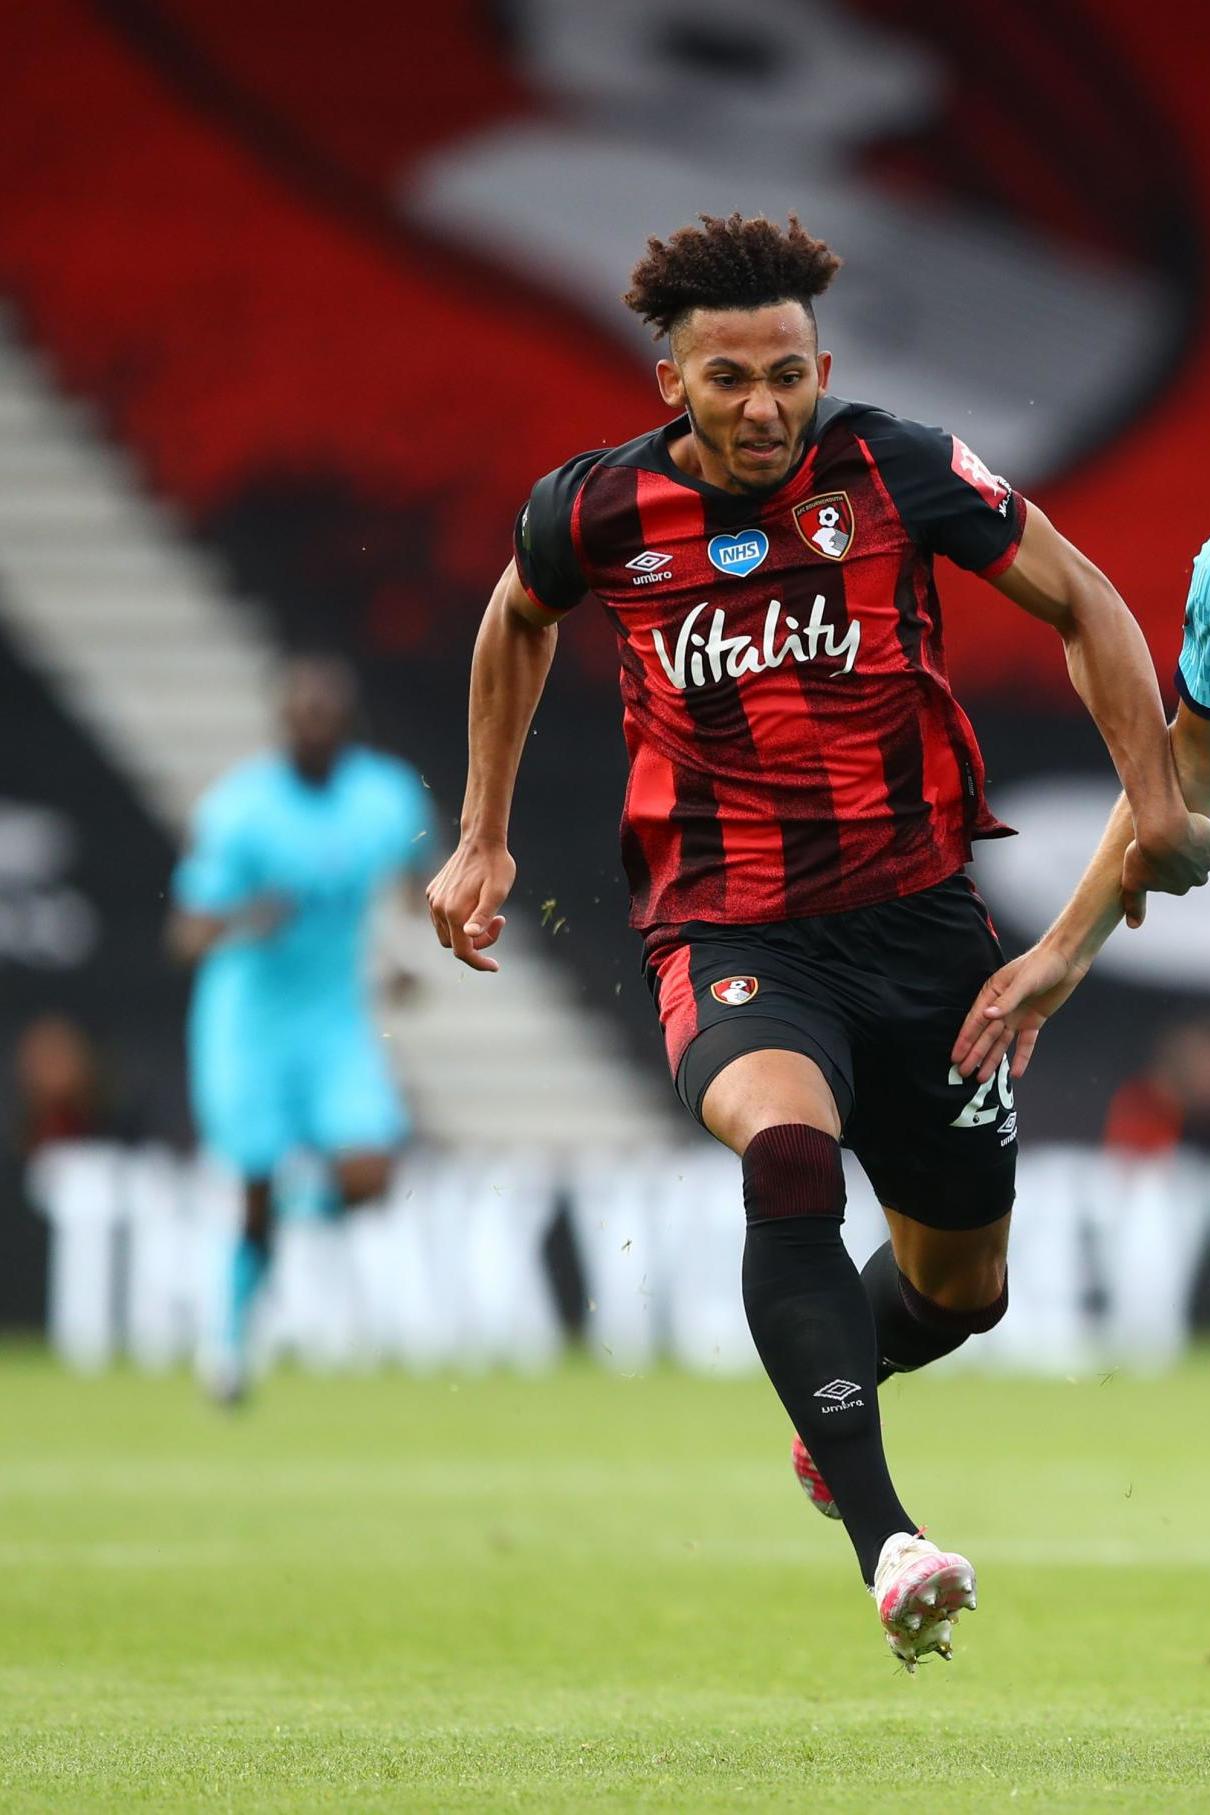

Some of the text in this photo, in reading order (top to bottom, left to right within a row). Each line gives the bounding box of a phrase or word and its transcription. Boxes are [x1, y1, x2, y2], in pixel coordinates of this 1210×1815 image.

[723, 543, 757, 563] NHS
[632, 571, 673, 585] umbro
[651, 594, 862, 690] Vitality
[821, 1400, 865, 1414] umbro
